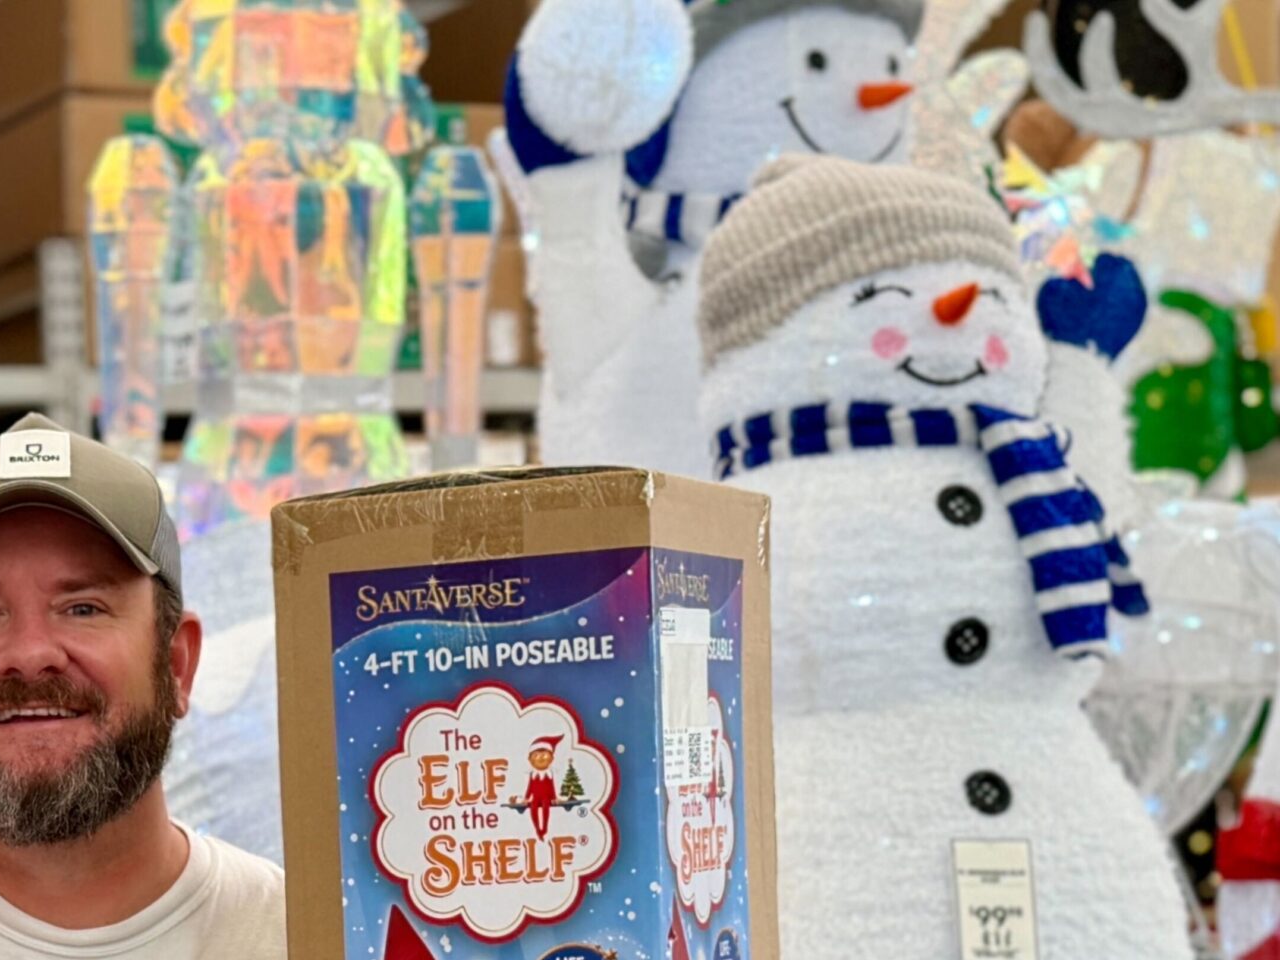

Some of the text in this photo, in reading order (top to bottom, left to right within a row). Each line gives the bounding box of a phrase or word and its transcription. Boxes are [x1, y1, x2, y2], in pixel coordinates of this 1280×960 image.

[9, 455, 60, 463] BRIXTON
[363, 635, 614, 676] 4-FT 10-IN POSEABLE
[440, 729, 482, 751] The
[418, 754, 509, 811] ELF
[429, 808, 499, 831] on the
